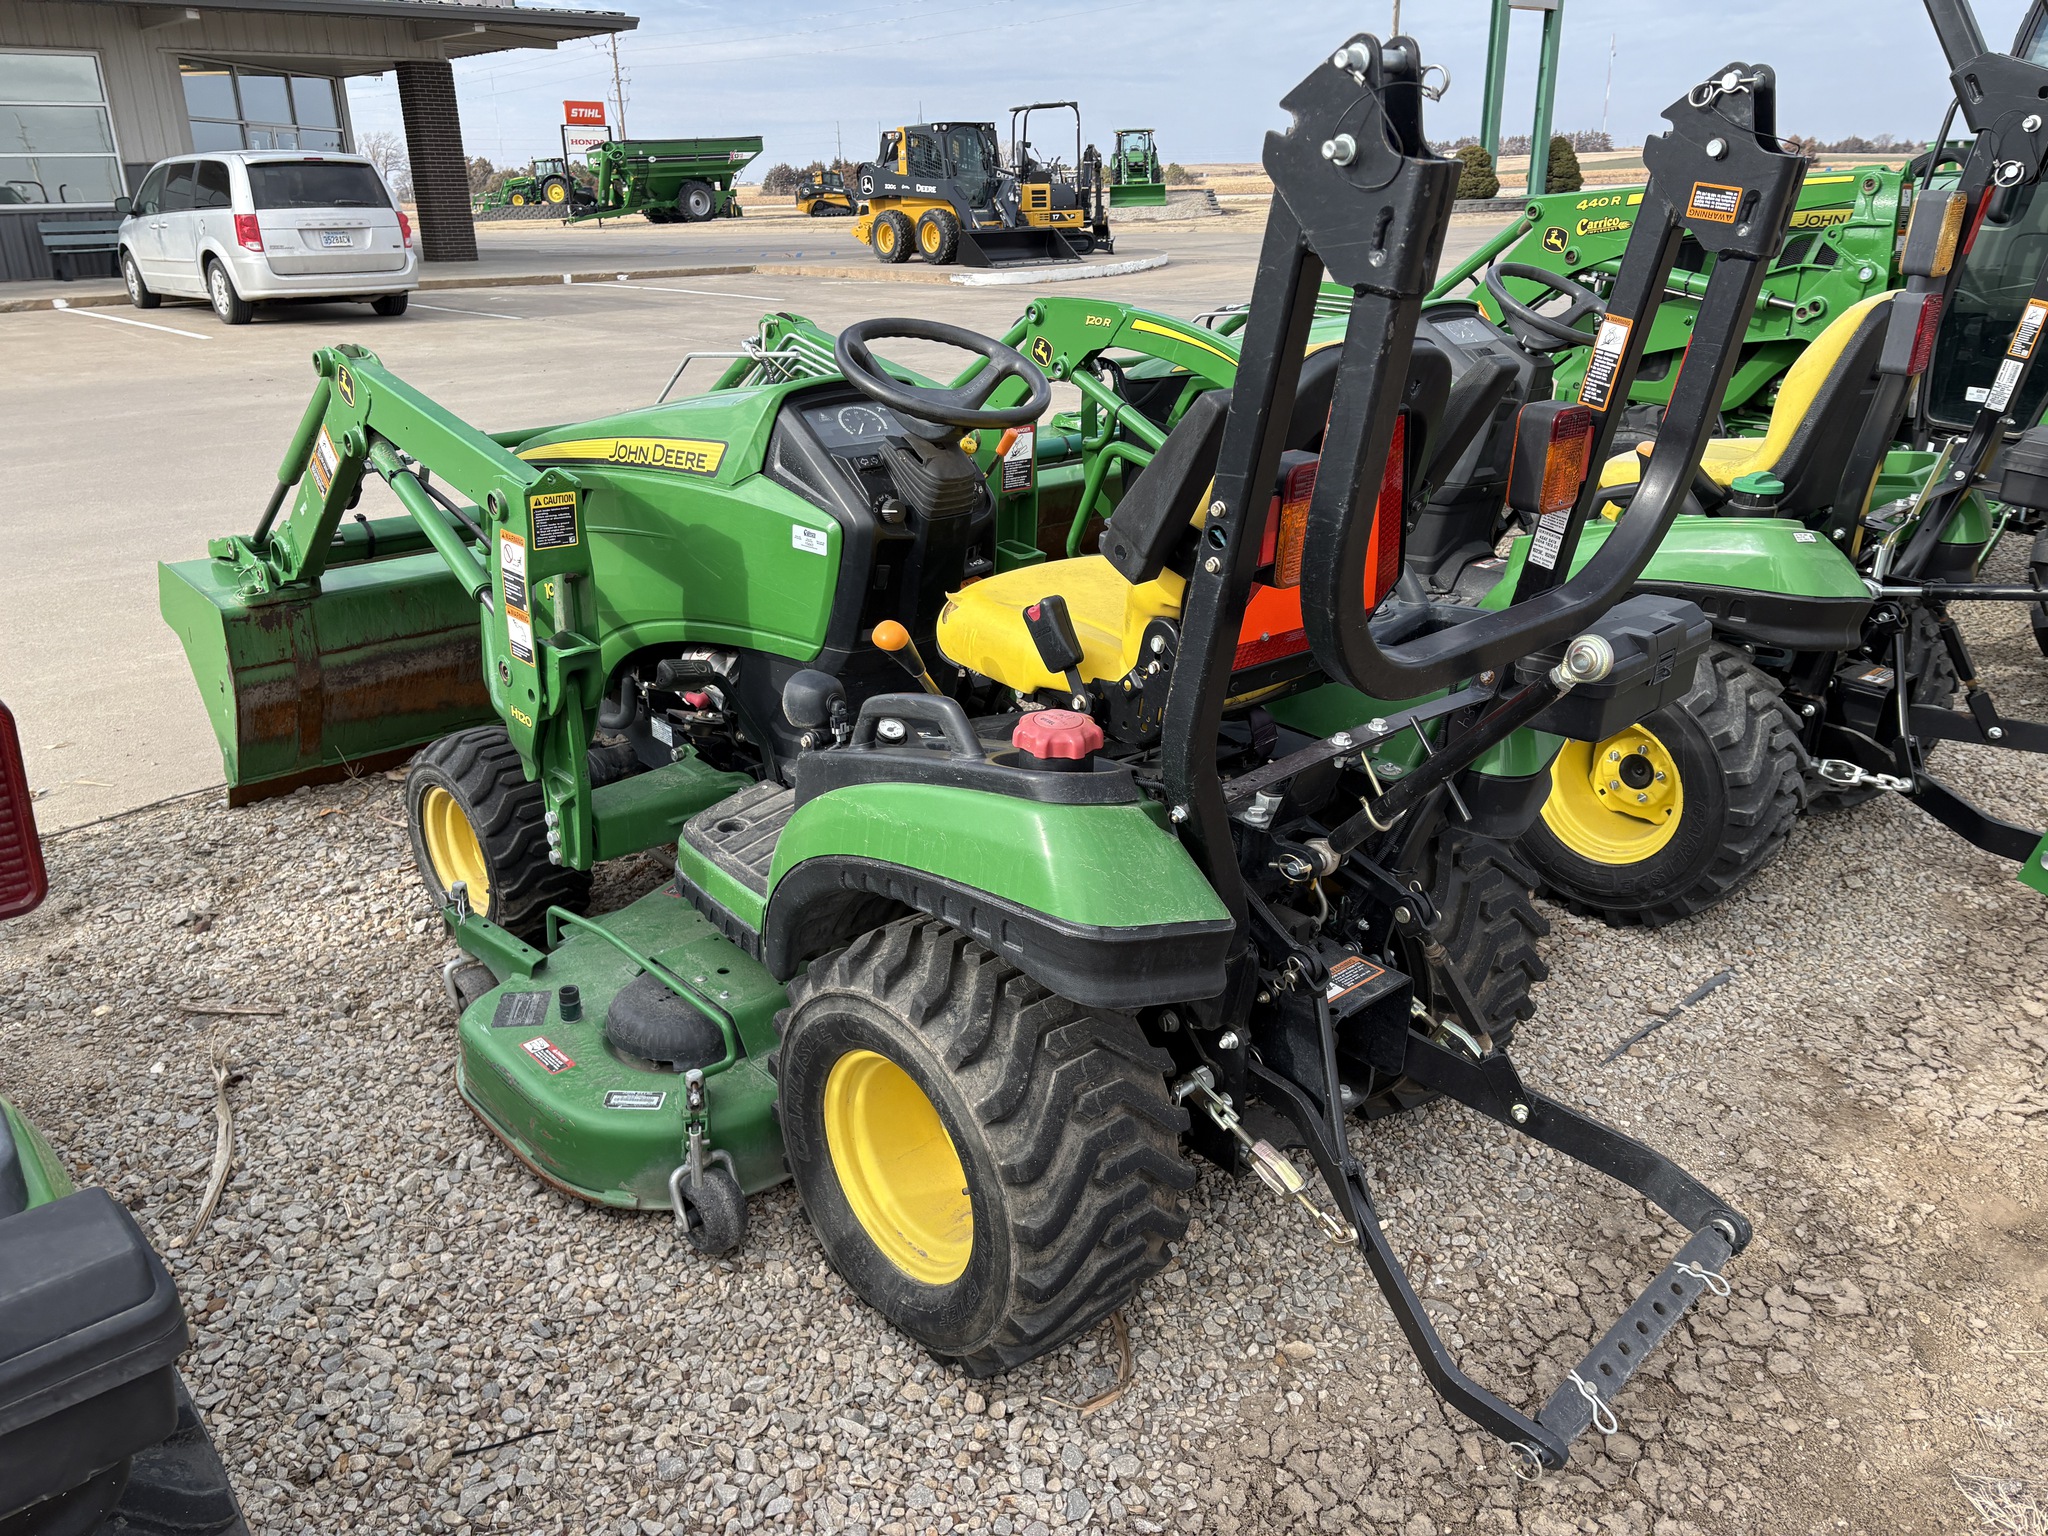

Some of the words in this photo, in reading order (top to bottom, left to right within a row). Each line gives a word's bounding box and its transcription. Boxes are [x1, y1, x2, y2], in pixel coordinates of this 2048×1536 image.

[571, 108, 602, 118] STIHL
[916, 184, 937, 193] DEERE
[1689, 209, 1725, 221] WARNING
[1797, 213, 1846, 226] JOHN
[1576, 217, 1620, 236] Carrico
[609, 441, 649, 461] JOHN
[652, 444, 708, 469] DEERE
[543, 494, 574, 506] CAUTION
